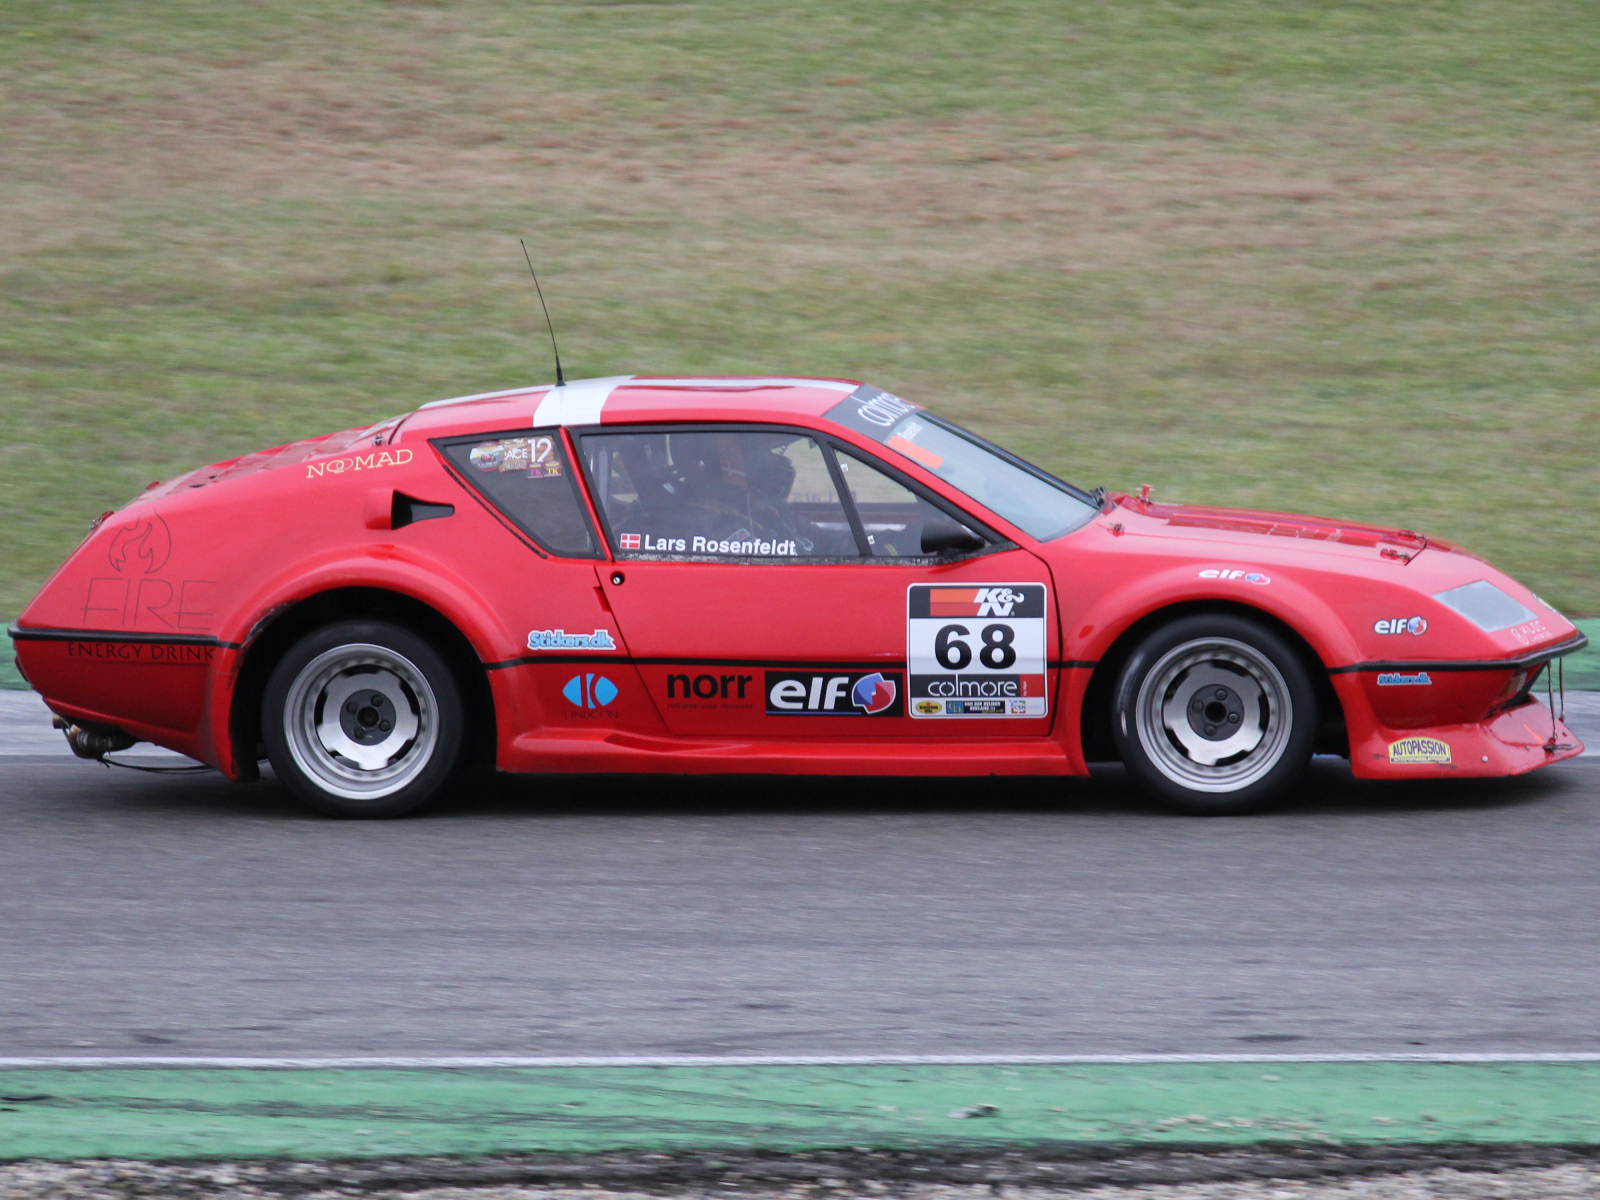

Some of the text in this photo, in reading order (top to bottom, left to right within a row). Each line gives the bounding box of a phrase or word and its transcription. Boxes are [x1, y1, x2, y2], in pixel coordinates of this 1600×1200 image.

[526, 437, 553, 463] 12
[644, 534, 687, 551] Lars
[692, 536, 797, 556] Rosenfeldt
[1198, 568, 1246, 580] elf
[80, 577, 216, 631] FIRE
[1374, 618, 1407, 634] elf
[528, 629, 616, 650] Stickers.dk
[934, 623, 1017, 671] 68
[68, 642, 215, 662] ENERGY DRINK
[666, 673, 753, 699] norr
[769, 676, 850, 711] elf
[927, 674, 1018, 697] colmore
[1392, 739, 1447, 757] AUTOPASSION
